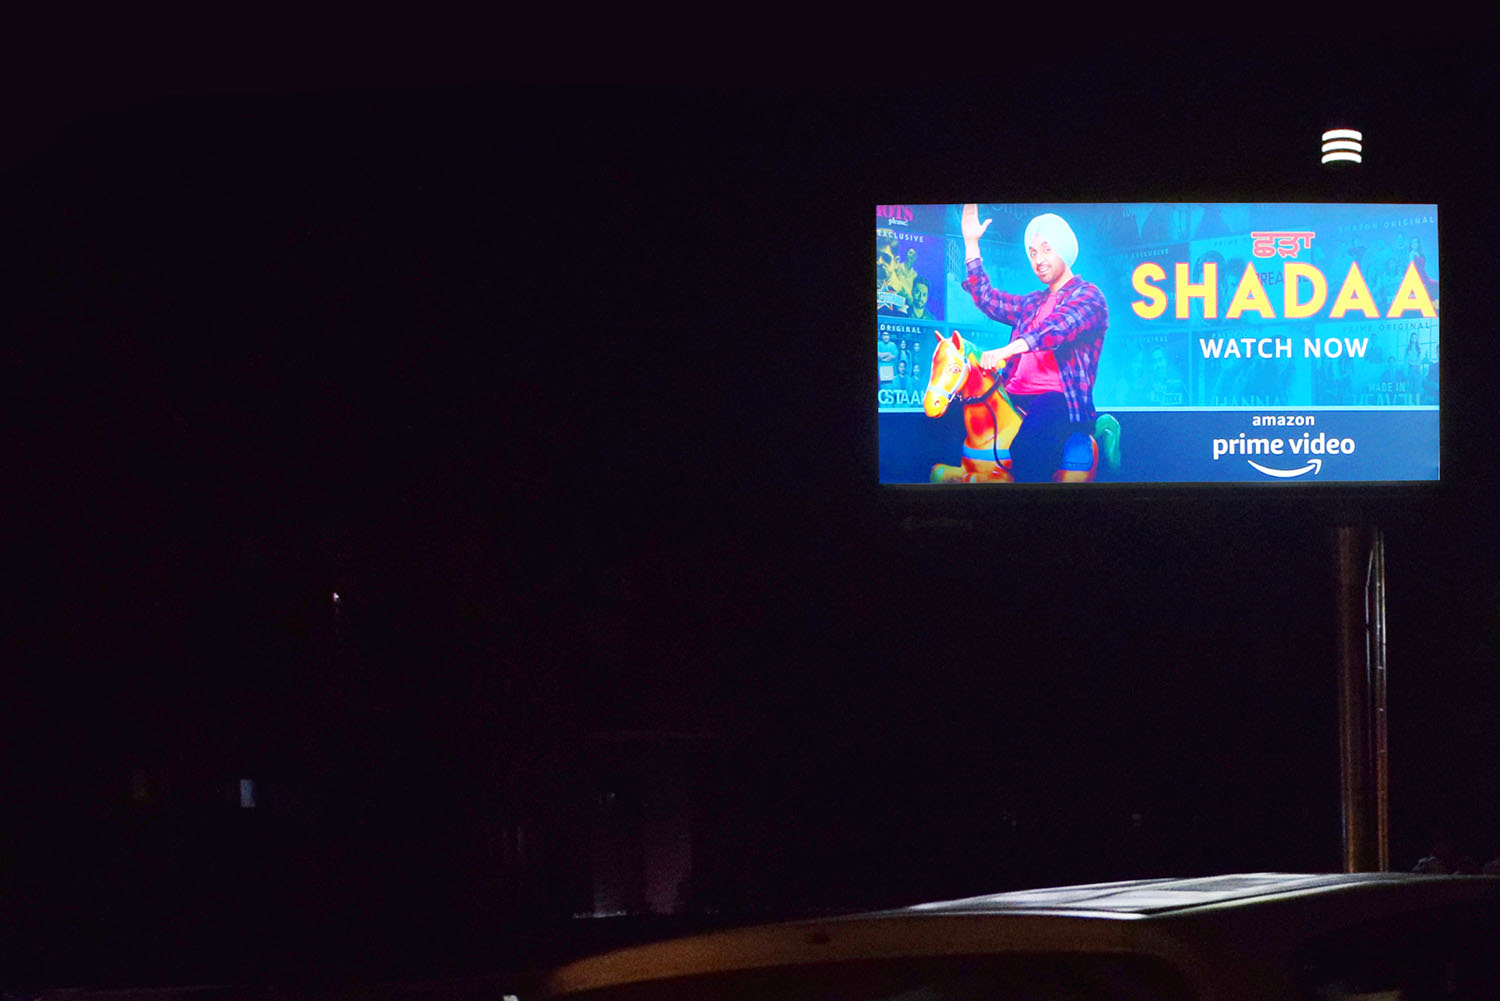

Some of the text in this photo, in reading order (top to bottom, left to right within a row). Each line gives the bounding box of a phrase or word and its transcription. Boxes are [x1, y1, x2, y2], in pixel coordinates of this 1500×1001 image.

[1131, 260, 1437, 319] SHADAA
[1199, 338, 1369, 358] WATCH NOW
[1252, 415, 1315, 426] amazon
[1213, 432, 1356, 460] prime video
